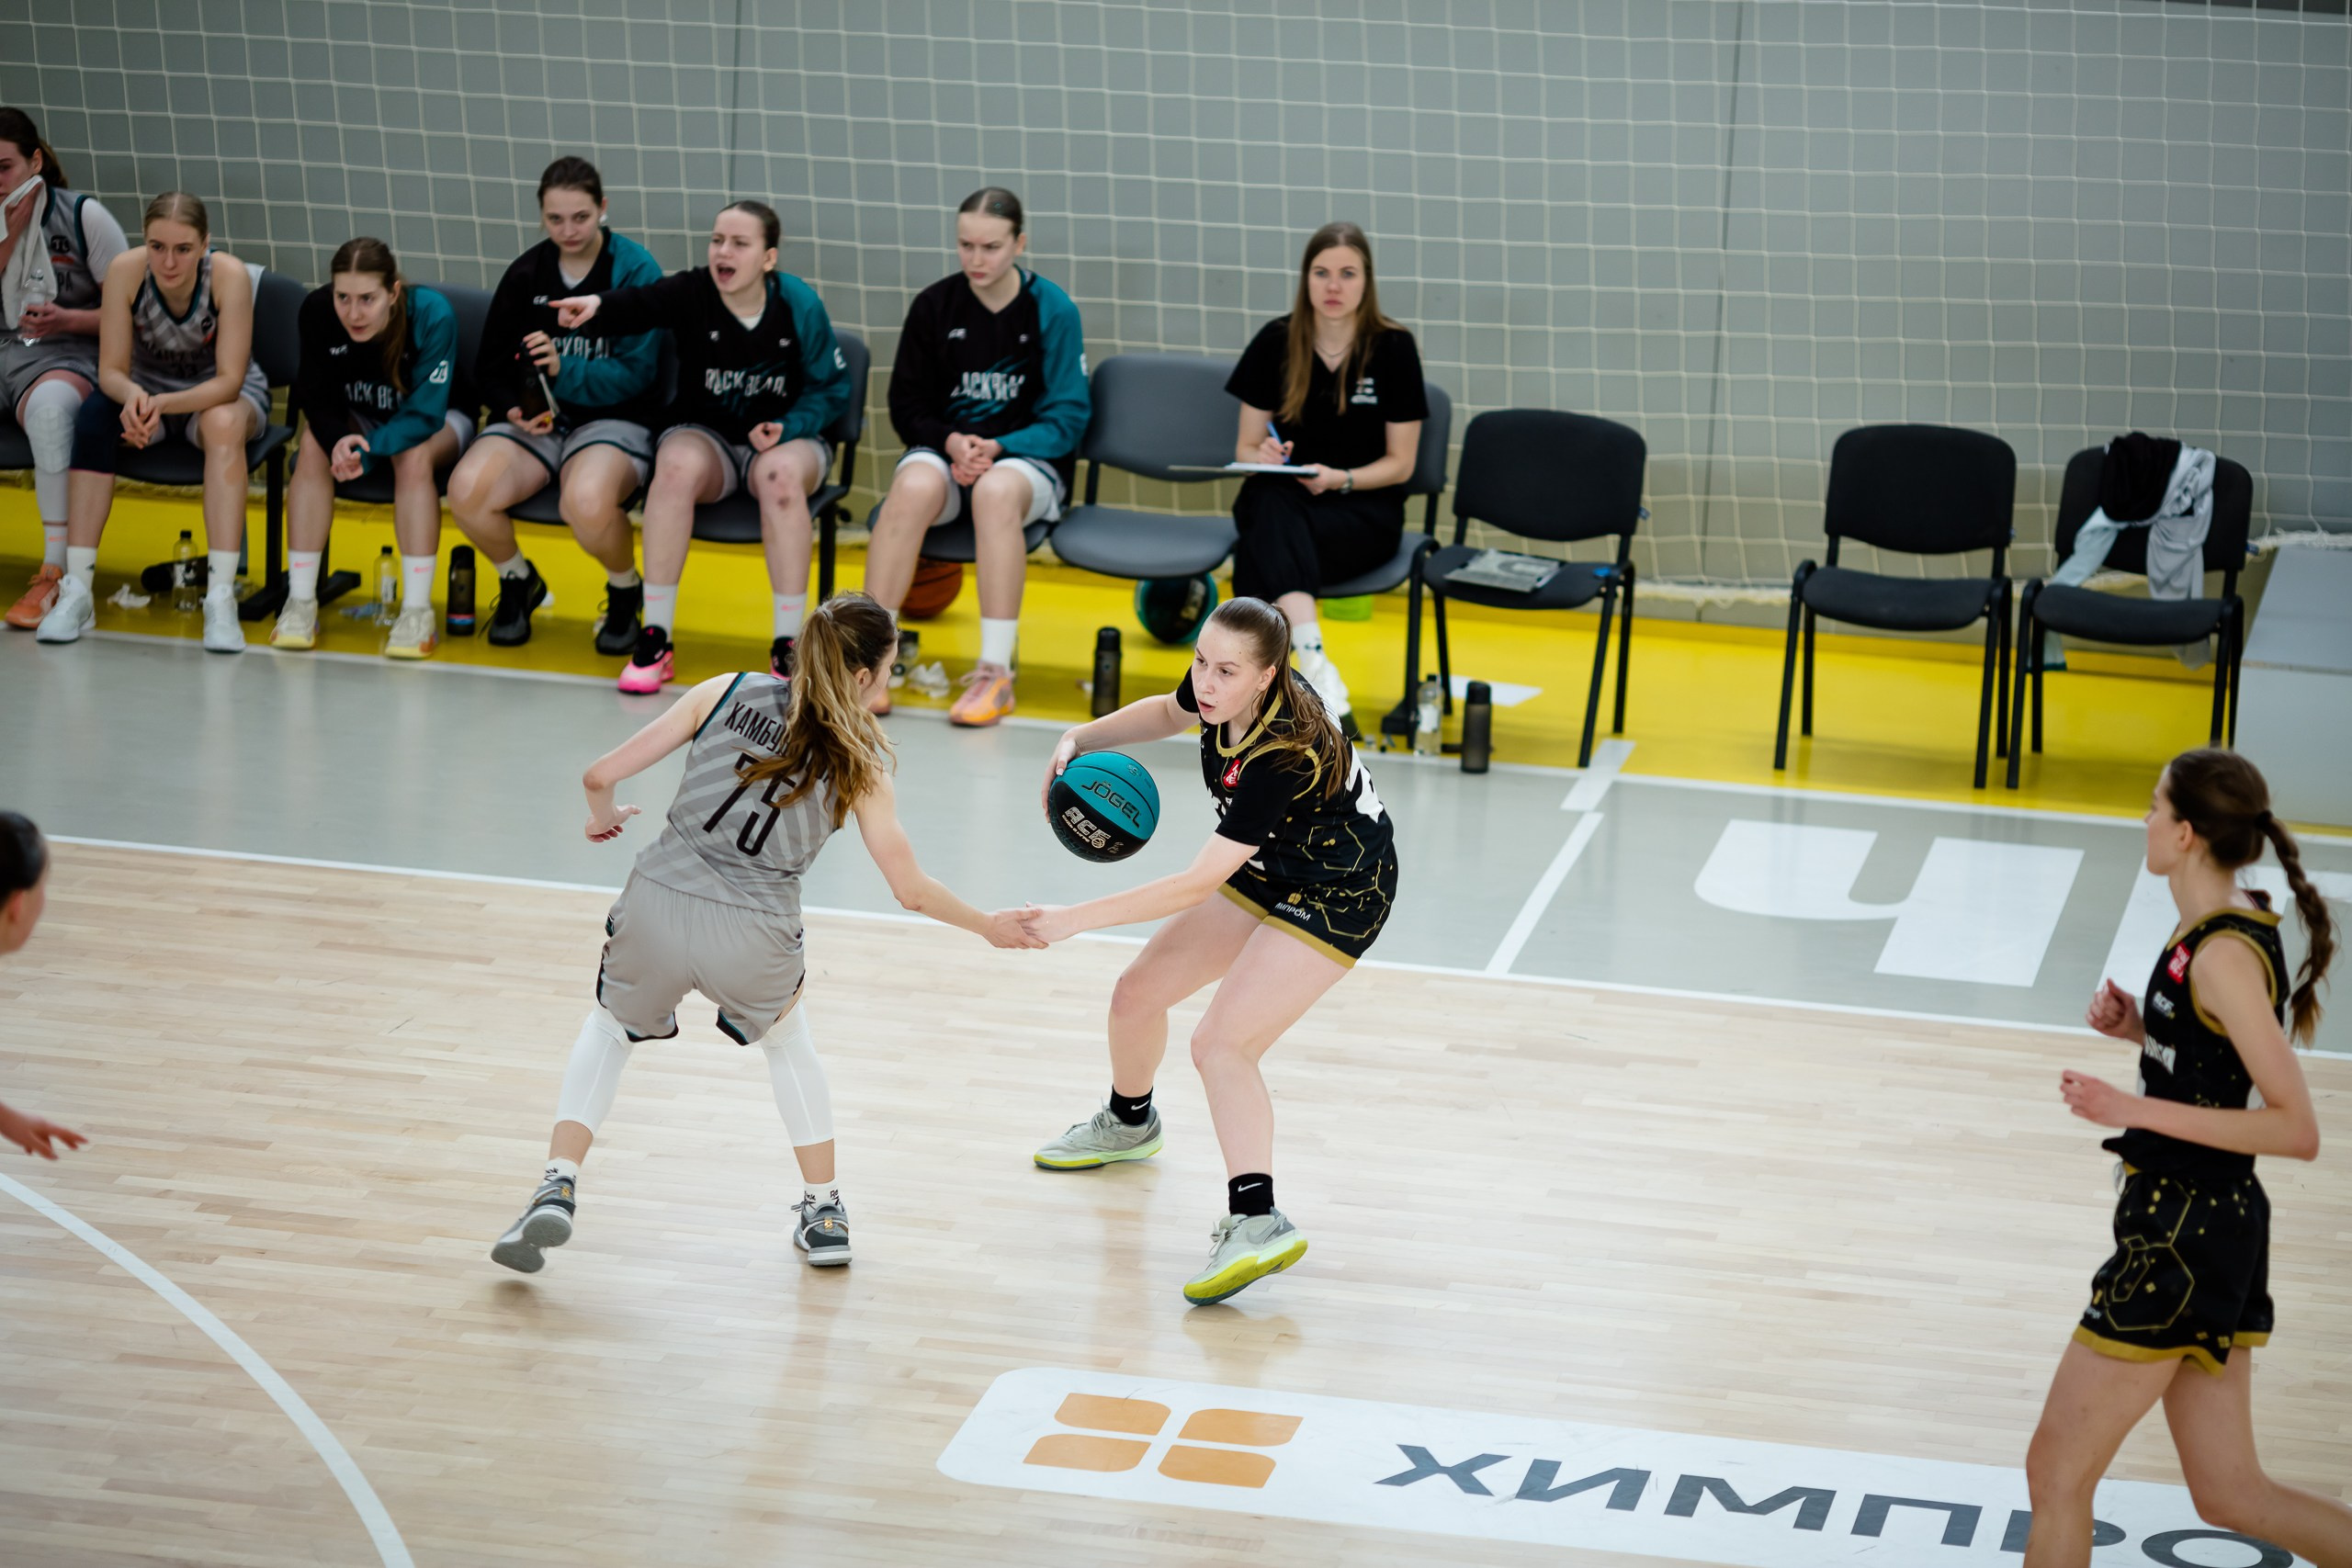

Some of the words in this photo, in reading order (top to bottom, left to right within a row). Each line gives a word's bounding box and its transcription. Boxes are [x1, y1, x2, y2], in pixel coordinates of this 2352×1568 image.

[702, 751, 797, 857] 75
[1080, 781, 1142, 829] JÖGEL
[1374, 1443, 2324, 1568] ХИМПРО
